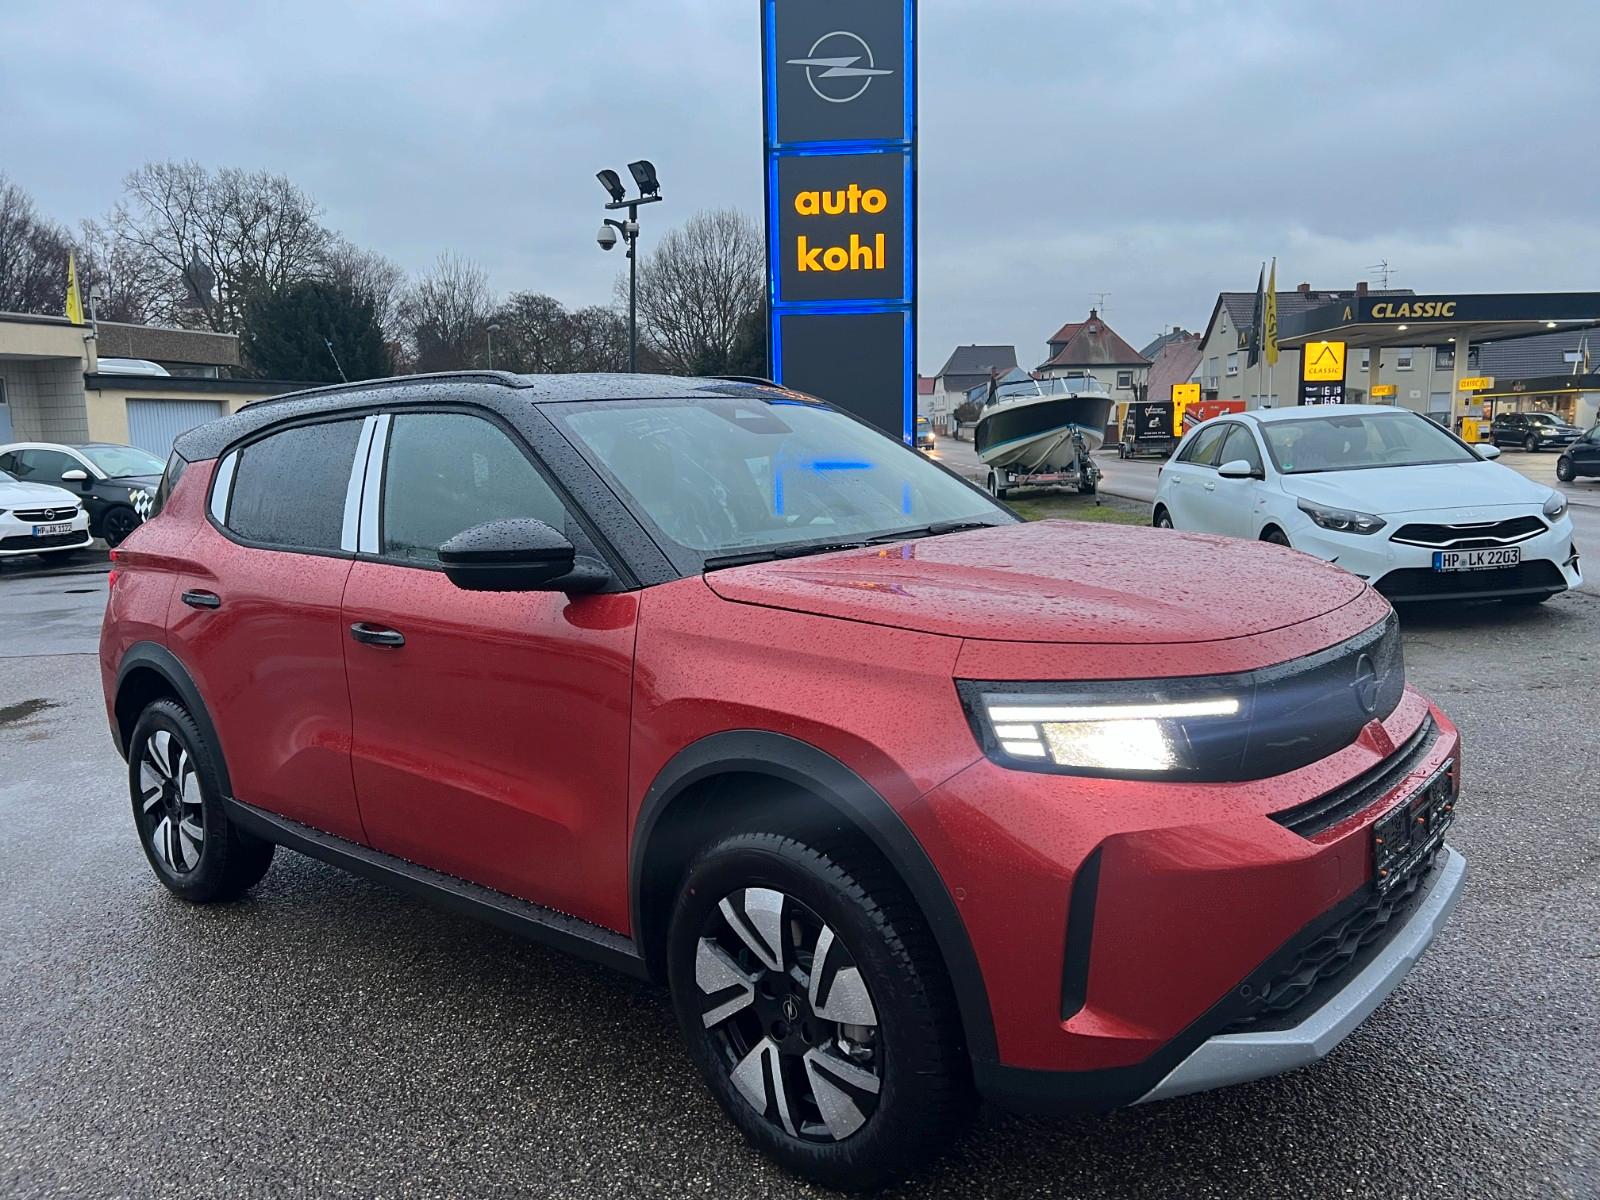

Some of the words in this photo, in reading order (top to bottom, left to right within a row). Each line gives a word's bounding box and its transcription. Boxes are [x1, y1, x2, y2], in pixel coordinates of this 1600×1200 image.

[794, 184, 887, 215] auto
[797, 233, 885, 272] kohl
[1371, 302, 1457, 318] CLASSIC
[38, 527, 46, 535] HP
[1443, 553, 1460, 567] HP
[1469, 552, 1485, 566] LK
[1488, 550, 1518, 564] 2203
